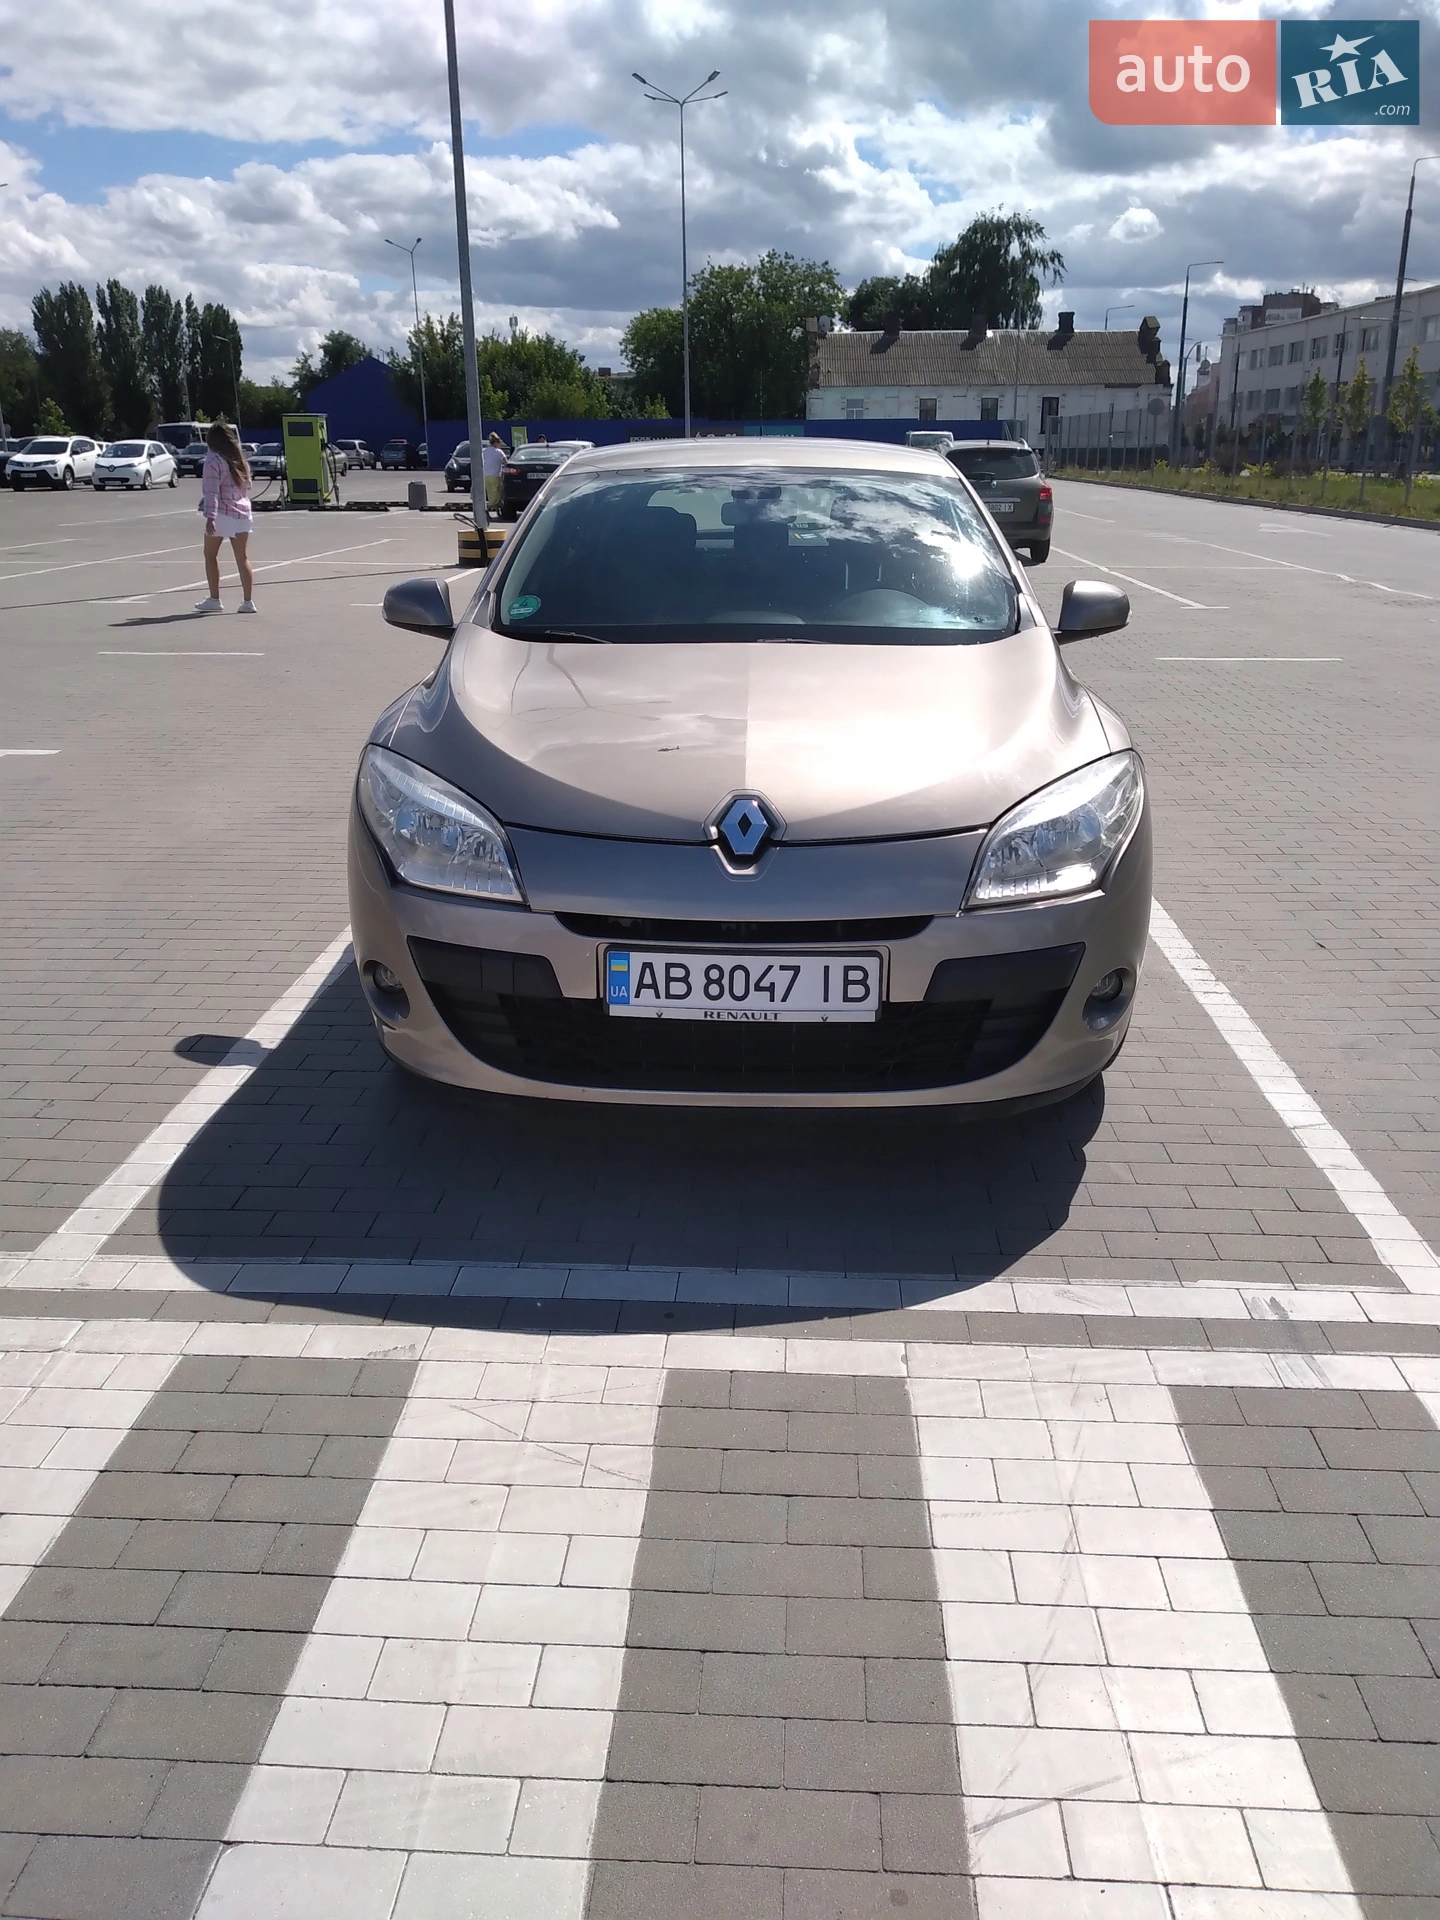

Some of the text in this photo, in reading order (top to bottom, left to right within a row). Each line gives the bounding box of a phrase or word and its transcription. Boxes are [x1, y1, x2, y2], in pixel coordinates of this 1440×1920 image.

[634, 961, 871, 1003] AB 8047 IB
[610, 985, 628, 998] UA
[703, 1010, 782, 1022] RENAULT
